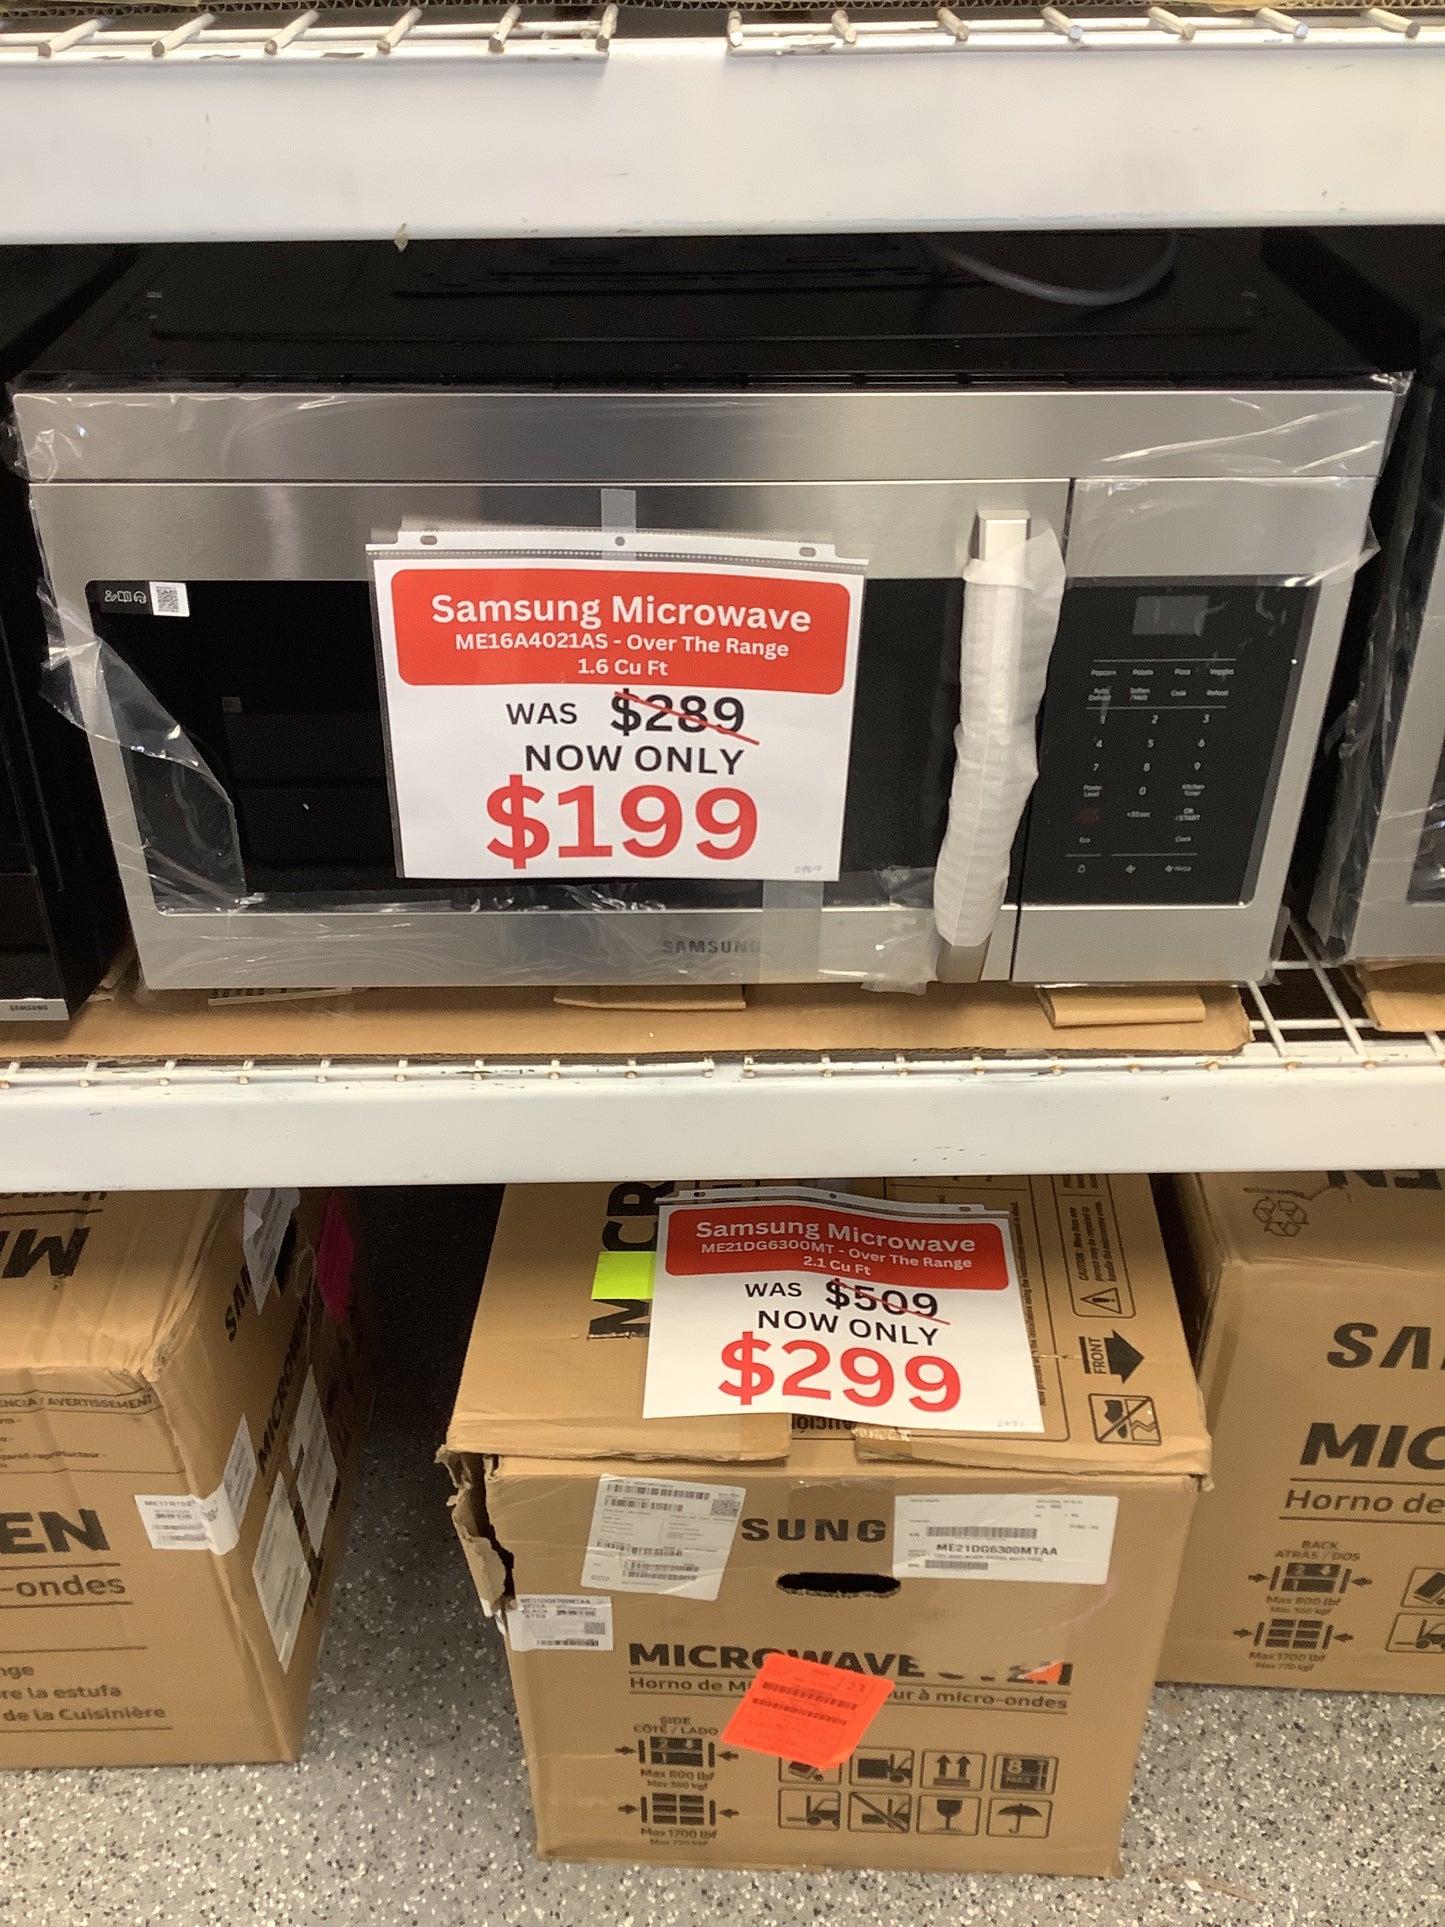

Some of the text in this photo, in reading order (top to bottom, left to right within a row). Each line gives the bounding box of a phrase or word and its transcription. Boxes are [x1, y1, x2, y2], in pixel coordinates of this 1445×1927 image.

[431, 594, 812, 632] Samsung Microwave
[455, 632, 608, 650] ME16A4021AS
[626, 634, 676, 652] Over
[681, 635, 720, 653] The
[725, 638, 789, 660] Range
[578, 658, 668, 677] 1.6 Cu Ft
[506, 688, 745, 736] WAS $289
[525, 744, 745, 775] NOW ONLY
[486, 774, 758, 870] $199
[661, 939, 760, 953] SAMSUNG
[695, 1219, 976, 1253] Samsung Microwave
[701, 1241, 834, 1256] ME21DG6300MT
[849, 1247, 886, 1264] Over
[890, 1254, 919, 1268] The
[922, 1256, 972, 1271] Range
[803, 1256, 871, 1276] 2.1 Cu Ft
[745, 1278, 939, 1319] WAS $509
[757, 1309, 939, 1346] NOW ONLY
[1088, 1337, 1106, 1374] FRONT
[1327, 1322, 1445, 1370] SA
[718, 1330, 962, 1413] $299
[1285, 1489, 1445, 1514] Horno de
[937, 1543, 1058, 1556] ME21DG6300MTAA
[1301, 1540, 1339, 1550] BACK
[1332, 1552, 1361, 1561] DOS
[27, 1686, 49, 1700] la
[53, 1684, 122, 1699] estufa
[630, 1677, 693, 1690] Horno
[698, 1679, 723, 1692] de
[3, 1706, 166, 1722] de la Cuisinière
[1007, 1760, 1023, 1774] 8
